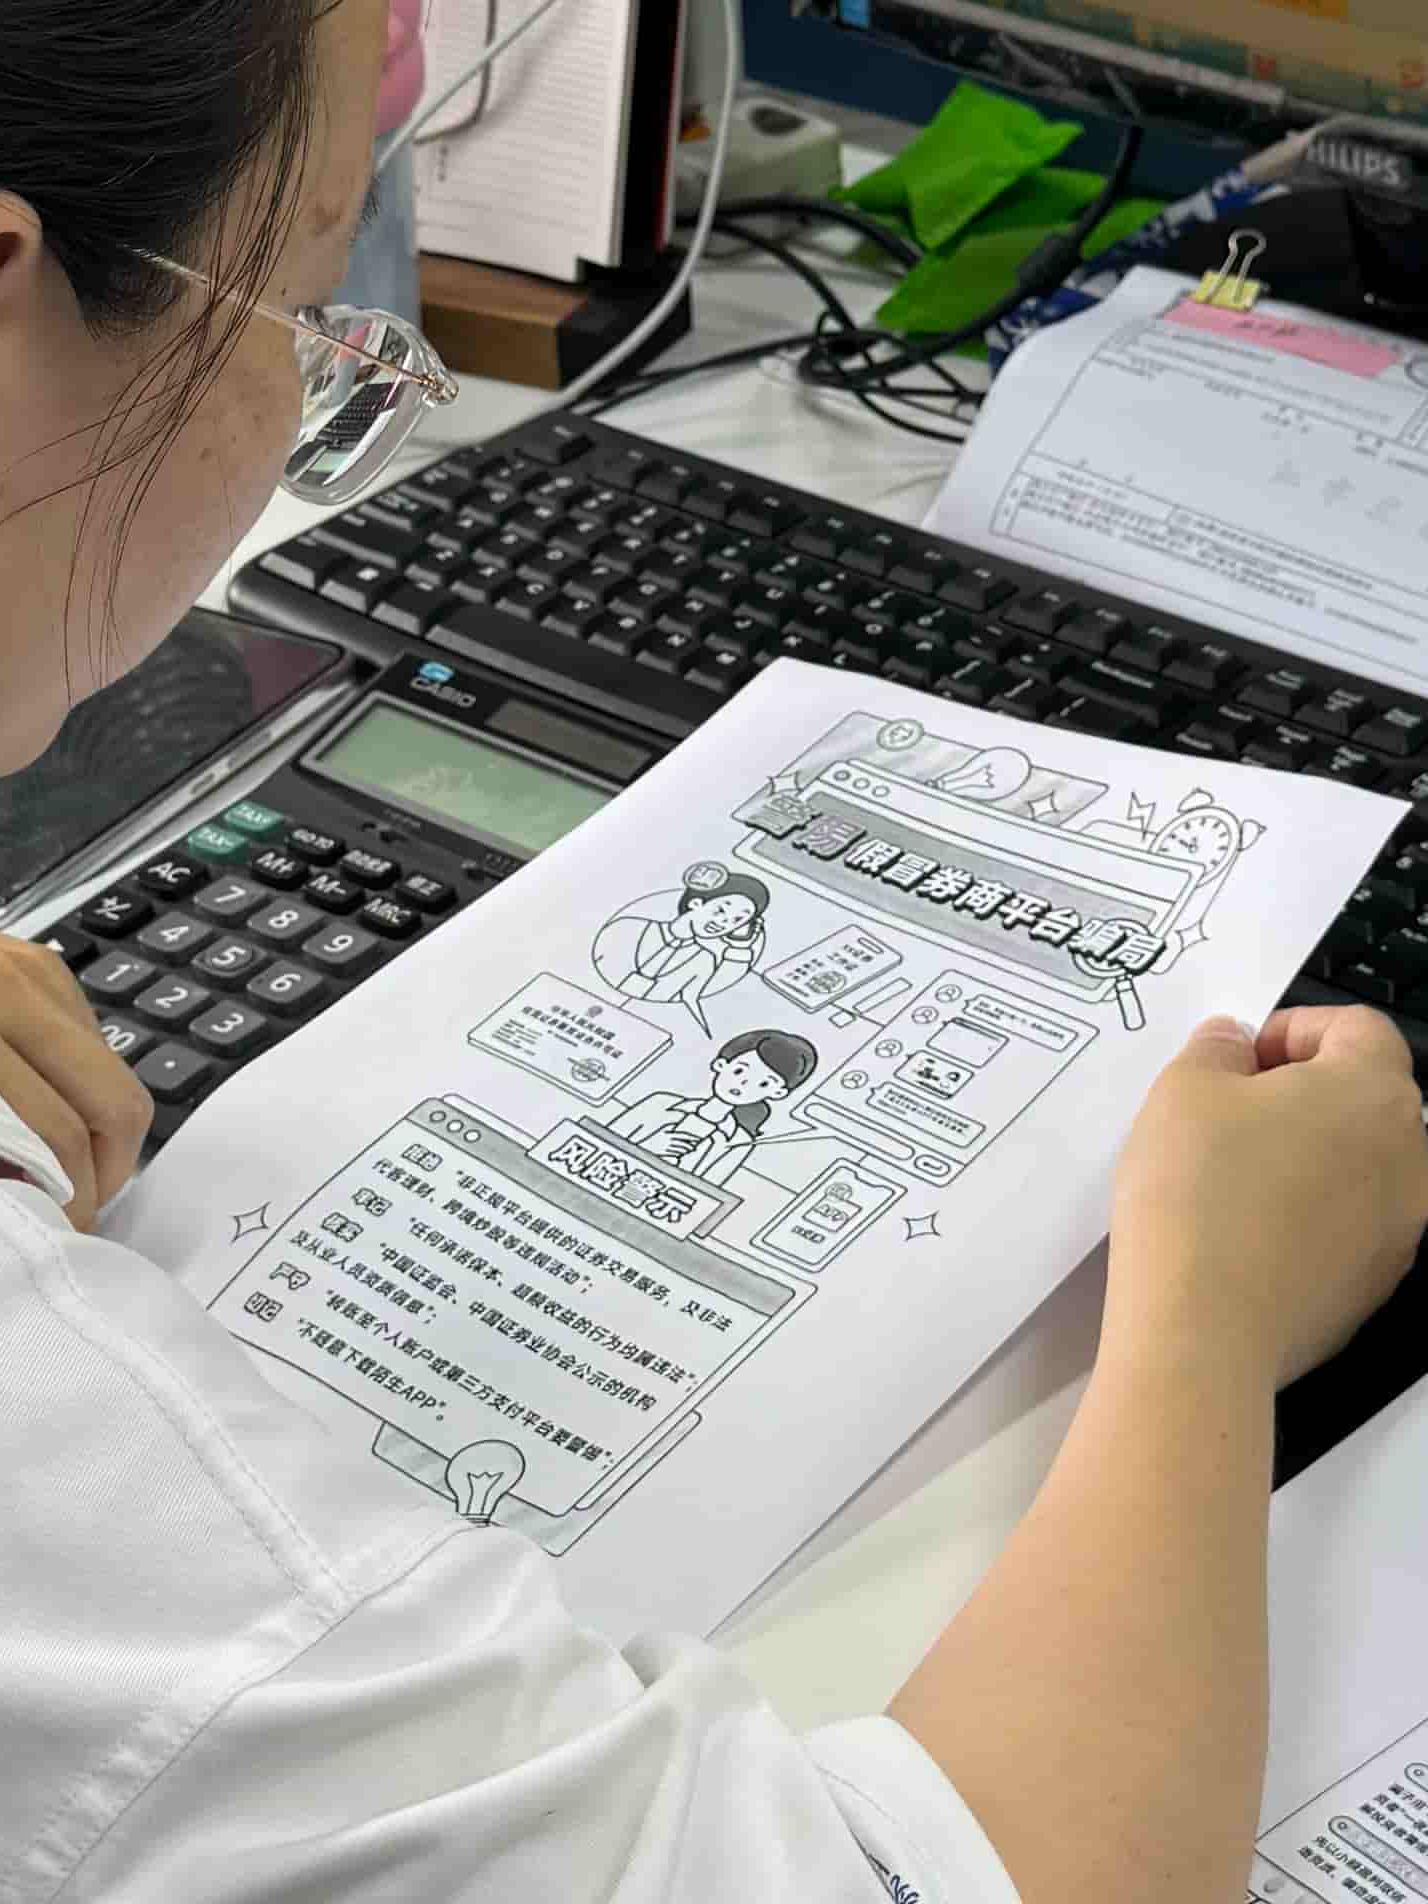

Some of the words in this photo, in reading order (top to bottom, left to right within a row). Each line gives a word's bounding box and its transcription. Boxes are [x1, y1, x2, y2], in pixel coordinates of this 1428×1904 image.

[1306, 142, 1401, 185] HILIPS
[410, 676, 476, 710] CASIO
[147, 861, 191, 885] AC
[256, 852, 295, 873] M+
[215, 887, 247, 906] 7
[266, 909, 302, 932] 8
[365, 897, 412, 924] MRC
[160, 923, 191, 943] 4
[323, 934, 354, 955] 9
[212, 945, 246, 967] 5
[104, 963, 133, 982] 1
[271, 972, 301, 993] 6
[157, 986, 189, 1008] 2
[214, 1012, 246, 1034] 3
[546, 1132, 698, 1228] 风险警示
